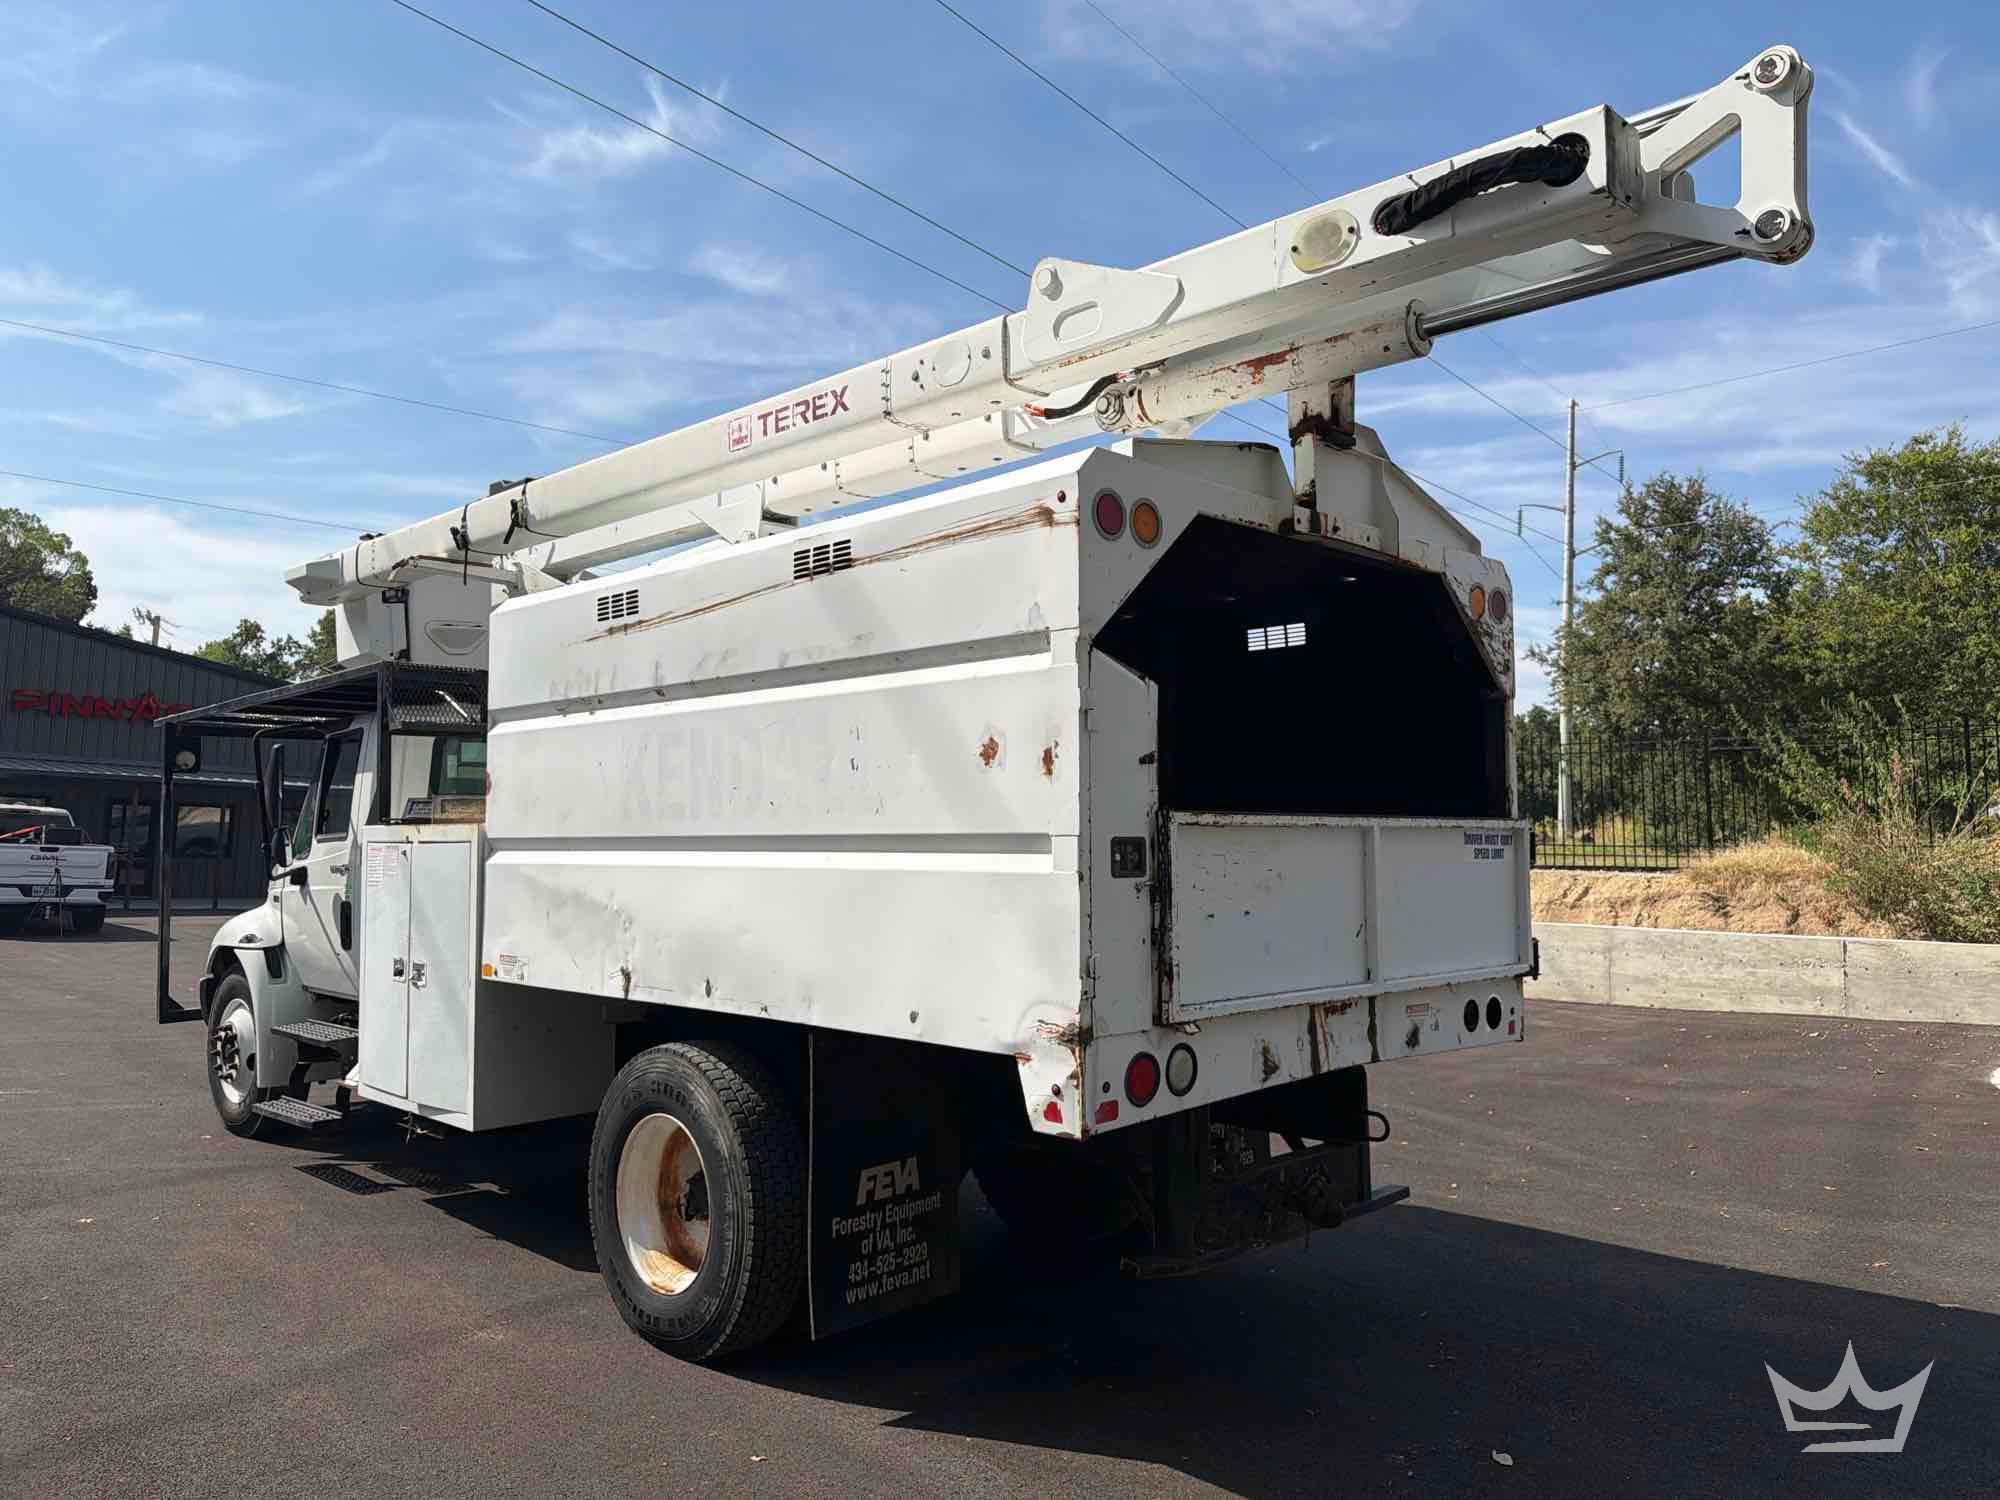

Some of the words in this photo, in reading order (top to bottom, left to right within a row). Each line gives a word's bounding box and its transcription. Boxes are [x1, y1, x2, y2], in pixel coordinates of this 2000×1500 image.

[757, 384, 850, 438] TEREX
[856, 1155, 920, 1206] FEVA
[832, 1210, 883, 1239] Forestry
[885, 1191, 941, 1225] Equipment
[861, 1233, 874, 1255] of
[846, 1260, 931, 1305] www.feva.net
